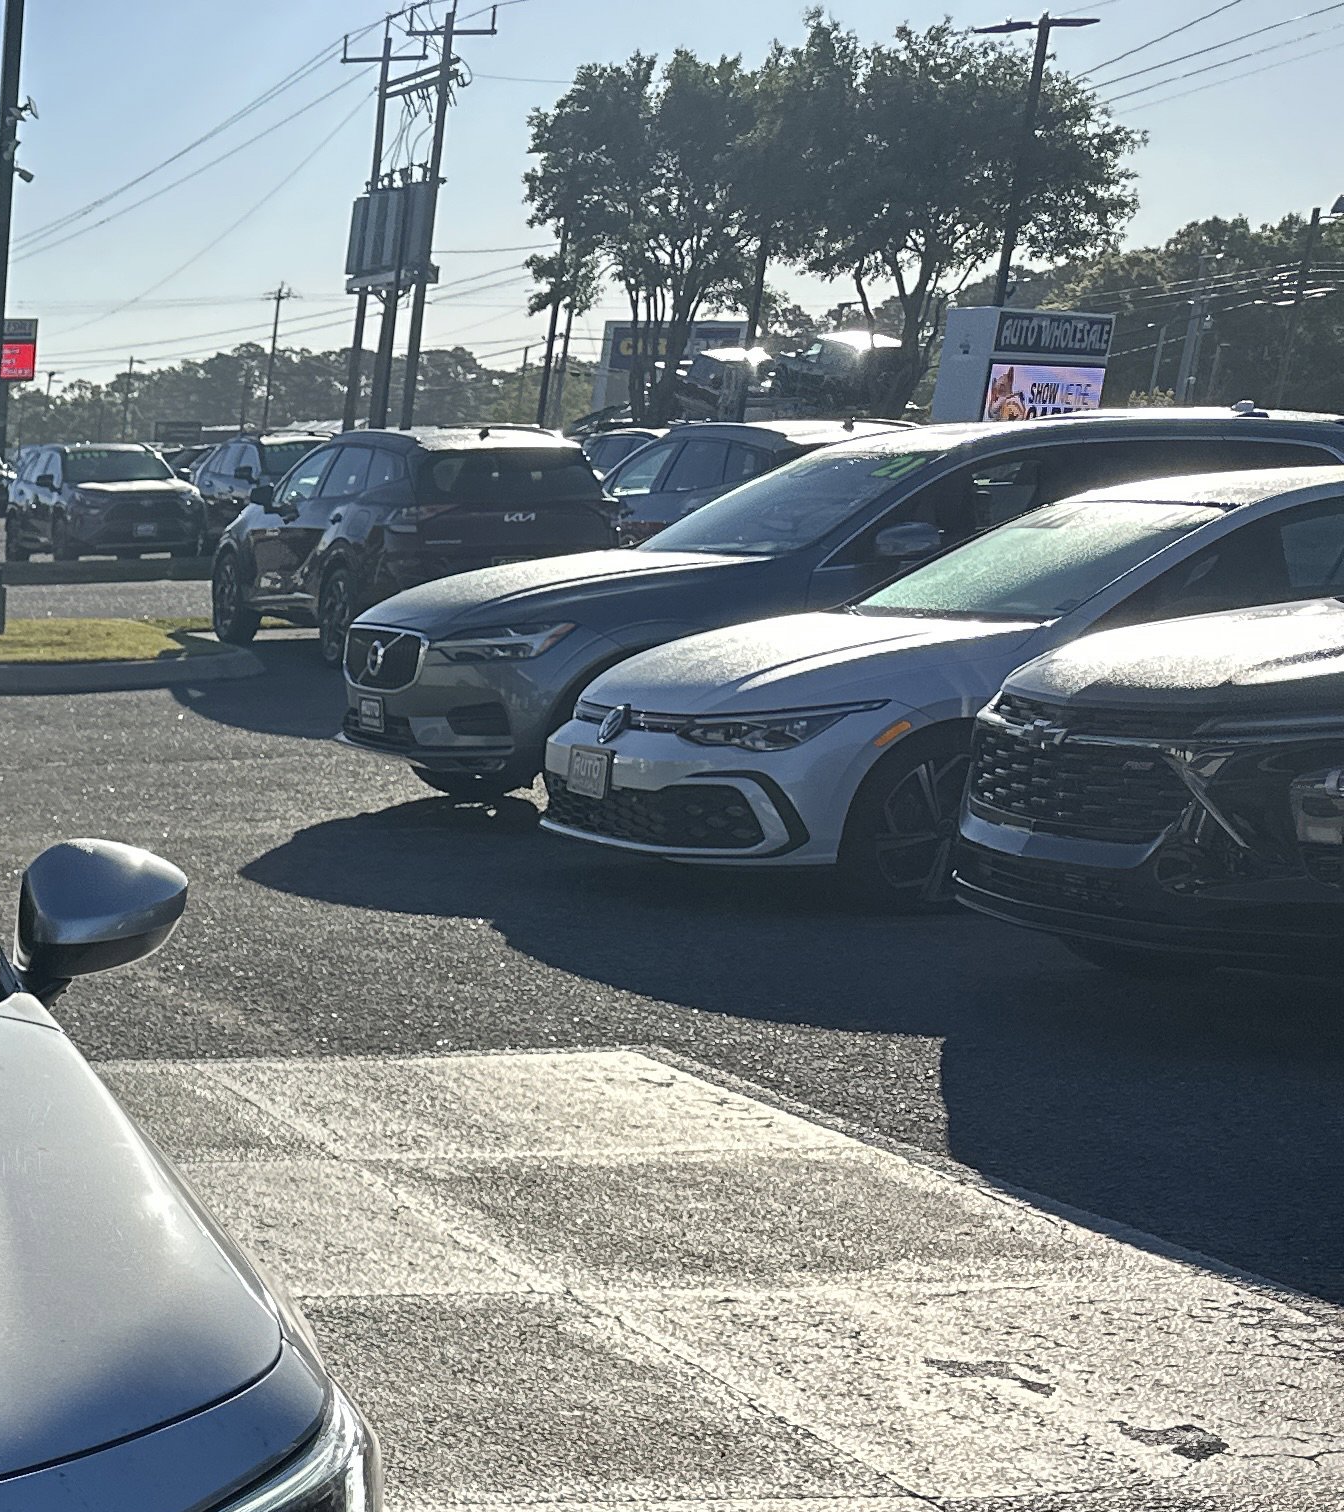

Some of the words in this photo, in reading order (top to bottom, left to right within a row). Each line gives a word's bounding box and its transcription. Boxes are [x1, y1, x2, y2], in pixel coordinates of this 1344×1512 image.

[1001, 319, 1039, 346] AUTO
[1040, 318, 1110, 350] WHOLESALE
[1028, 382, 1060, 404] SHOW
[573, 754, 601, 779] AUTO
